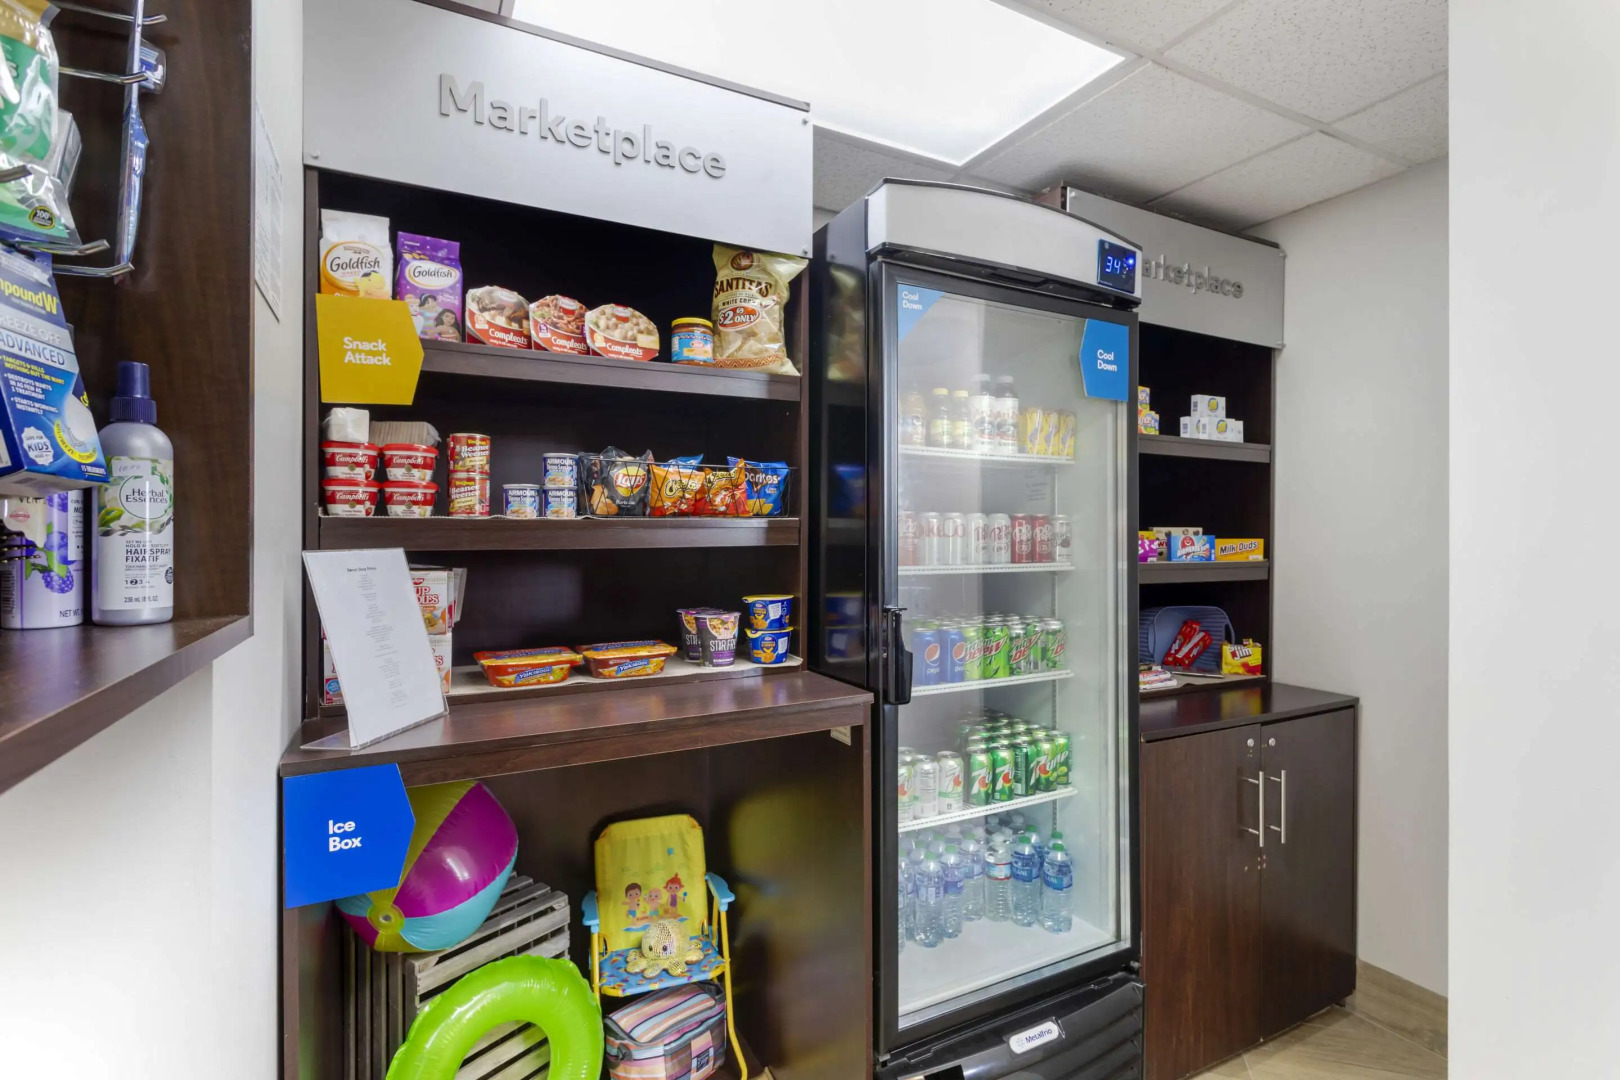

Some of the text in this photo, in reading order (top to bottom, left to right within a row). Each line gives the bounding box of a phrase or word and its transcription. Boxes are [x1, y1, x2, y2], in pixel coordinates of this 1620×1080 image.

[439, 73, 727, 178] Marketplace
[330, 255, 380, 272] Goldfish
[1105, 256, 1121, 274] 34
[413, 265, 453, 278] Goldfish
[1142, 254, 1244, 299] arketplace
[902, 291, 919, 300] Cool
[902, 300, 923, 310] Down
[734, 314, 756, 323] ONLY
[343, 336, 387, 351] Snack
[489, 328, 528, 345] Compleats
[552, 336, 588, 350] Compleats
[0, 332, 65, 365] ADVANCED
[607, 342, 644, 356] Compleats
[1097, 349, 1114, 361] Cool
[344, 350, 392, 365] Attack
[1097, 360, 1118, 372] Down
[27, 442, 50, 453] KIDS
[125, 494, 168, 504] Essences
[132, 488, 164, 497] Herbal
[1219, 540, 1259, 555] Milk Duds
[416, 586, 431, 595] UP
[709, 640, 727, 652] STIR
[519, 667, 550, 679] Yakisoba
[328, 819, 356, 835] Ice
[328, 836, 363, 852] Box
